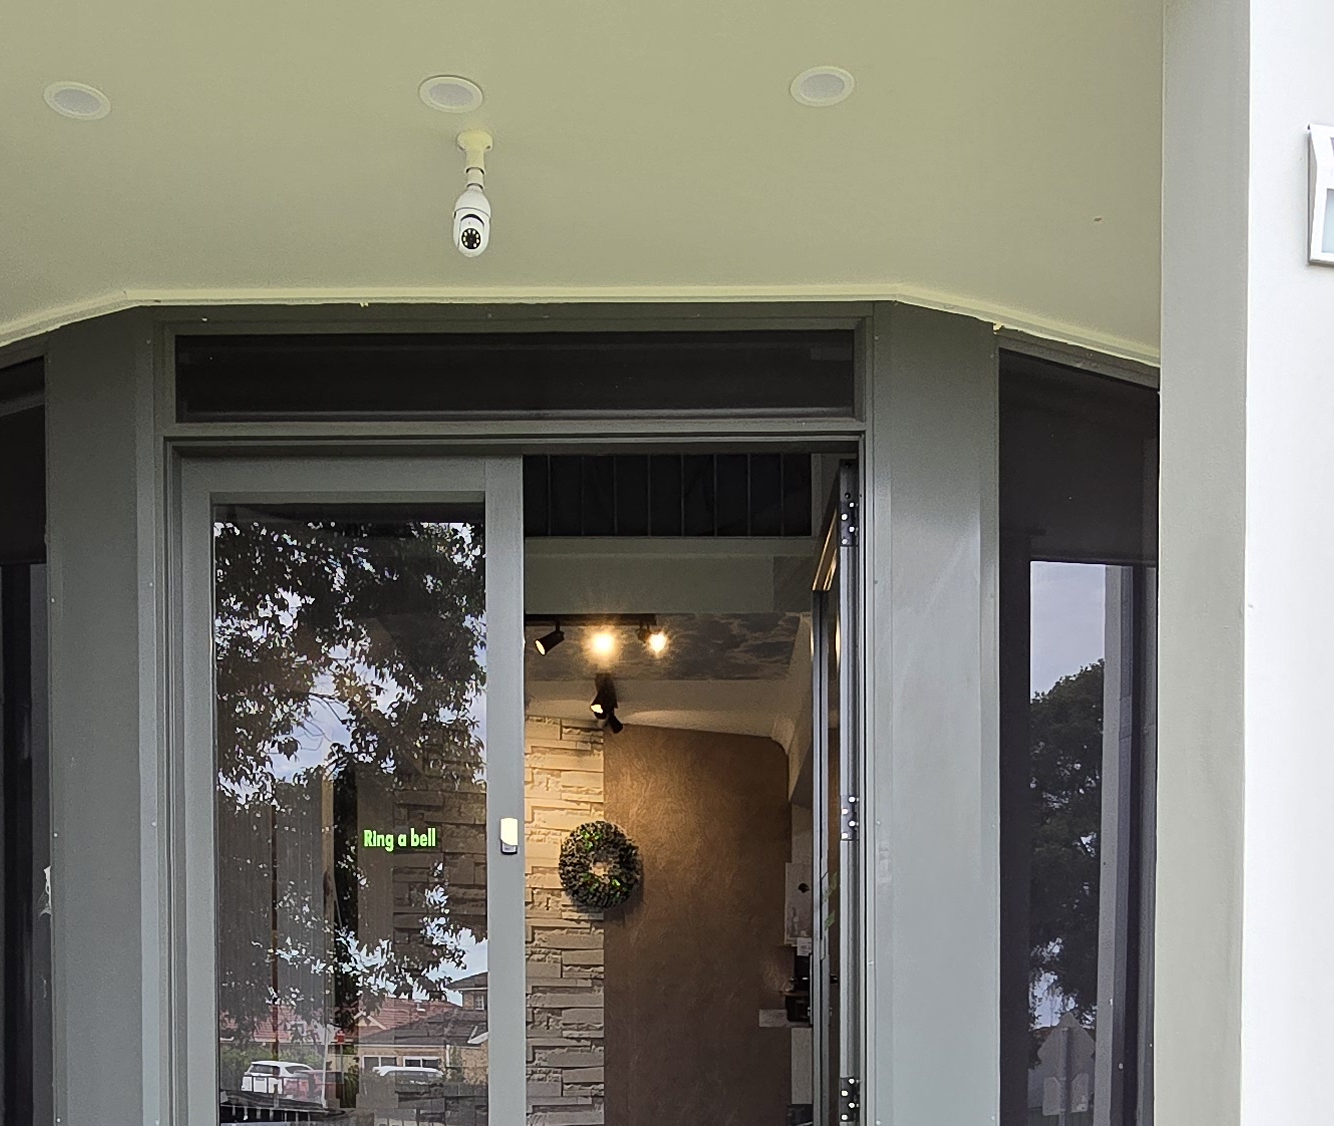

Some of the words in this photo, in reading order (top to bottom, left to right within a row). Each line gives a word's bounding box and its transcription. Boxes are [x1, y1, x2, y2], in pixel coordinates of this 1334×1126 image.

[363, 829, 394, 852] Ring
[397, 834, 407, 847] a
[410, 828, 436, 847] bell
